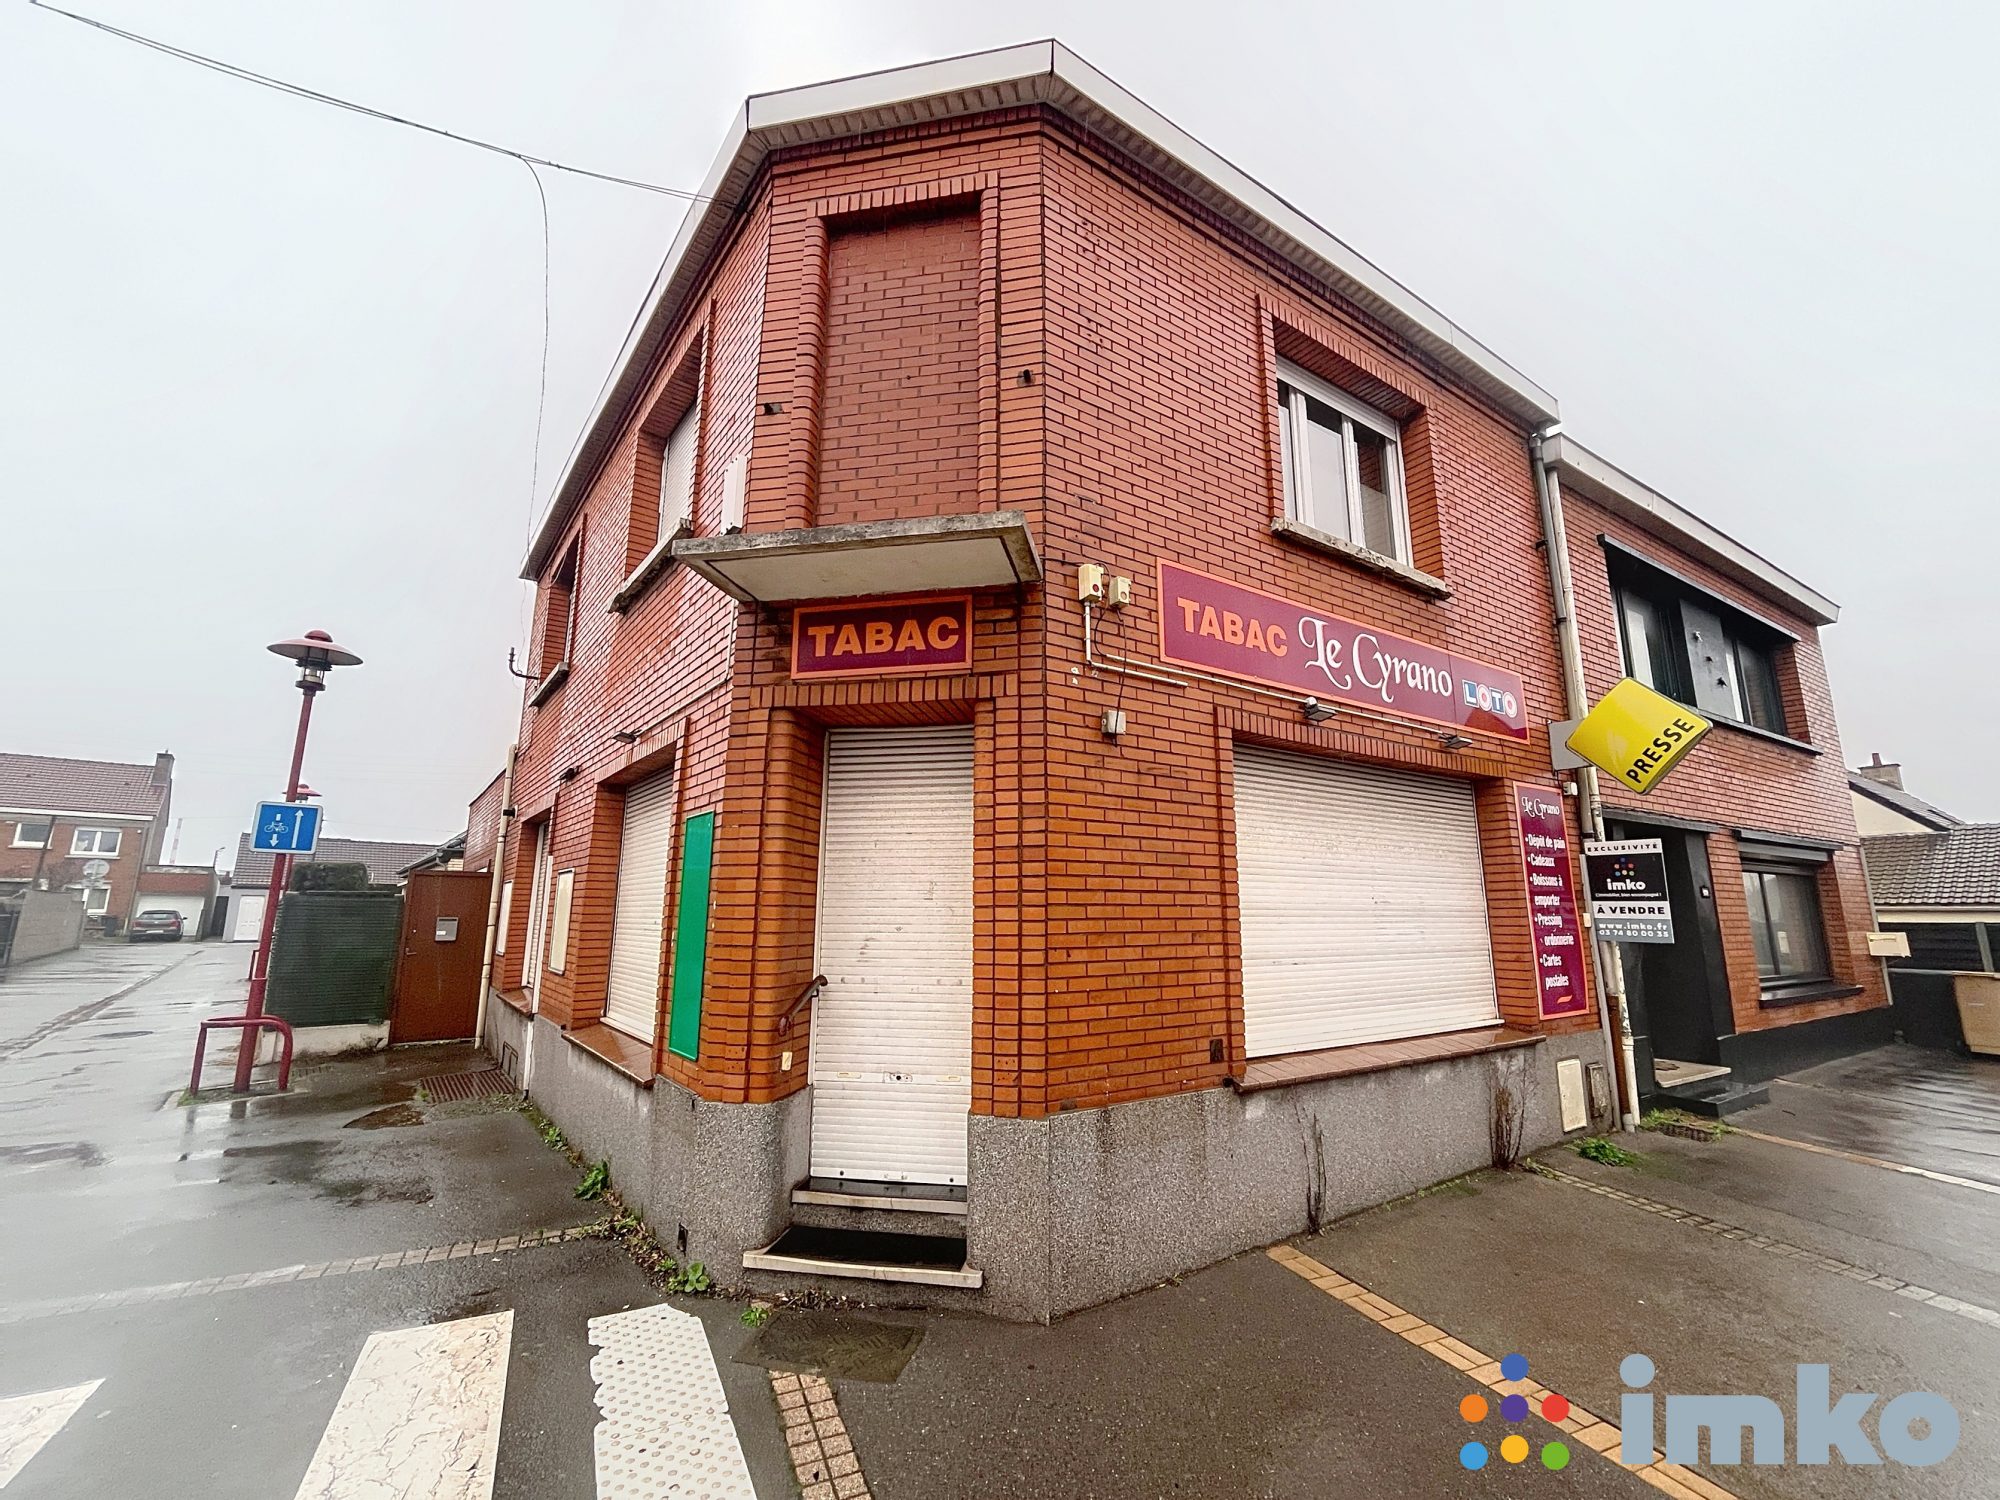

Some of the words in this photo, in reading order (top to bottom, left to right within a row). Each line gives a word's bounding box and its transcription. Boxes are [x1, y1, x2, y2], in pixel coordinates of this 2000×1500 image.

[808, 616, 959, 657] TABAC
[1177, 597, 1288, 657] TABAC
[1298, 616, 1352, 690] Le
[1352, 633, 1453, 703] Cyrano
[1462, 679, 1518, 718] LOTO
[1625, 718, 1695, 784] PRESSE
[1521, 796, 1535, 818] Le
[1528, 833, 1546, 850] Dépôt
[1545, 836, 1553, 848] de
[1553, 837, 1566, 851] pain
[1587, 842, 1657, 852] EXCLUSIVITÉ
[1530, 853, 1555, 867] Cadeaux
[1532, 872, 1558, 887] Boissons
[1557, 874, 1563, 887] à
[1606, 878, 1646, 891] imko
[1534, 894, 1560, 908] emporter
[1597, 904, 1606, 914] À
[1608, 906, 1666, 915] VENDRE
[1537, 913, 1563, 929] Pressing
[1598, 921, 1668, 931] www.imko.fr
[1543, 953, 1562, 967] Cartes
[1545, 973, 1569, 990] postales
